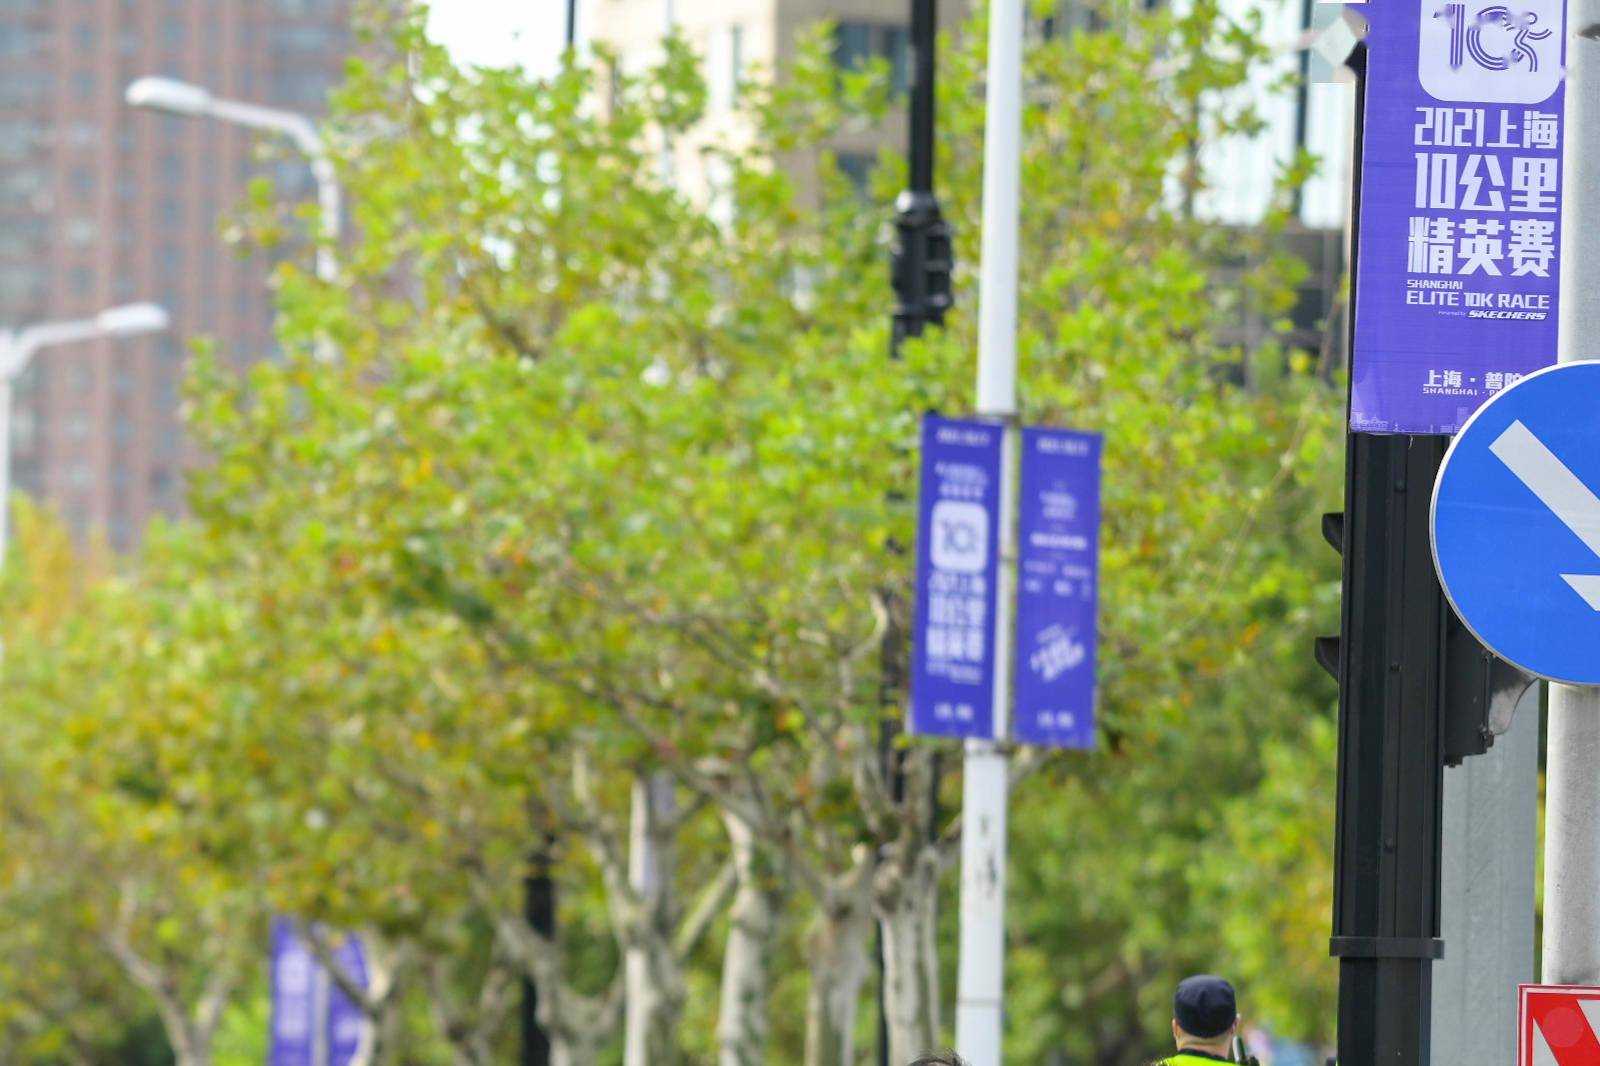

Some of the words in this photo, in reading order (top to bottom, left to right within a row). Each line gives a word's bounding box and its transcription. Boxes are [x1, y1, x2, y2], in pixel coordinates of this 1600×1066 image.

[1414, 107, 1558, 149] 2021上海
[1415, 153, 1558, 213] 10公里
[1407, 216, 1555, 278] 精英赛
[1407, 279, 1463, 290] SHANGHAI
[1406, 290, 1459, 306] ELITE
[1464, 292, 1494, 307] 10K
[1498, 293, 1550, 310] RACE
[1467, 309, 1548, 321] SKECHERS
[1423, 387, 1478, 397] SHANGHAI
